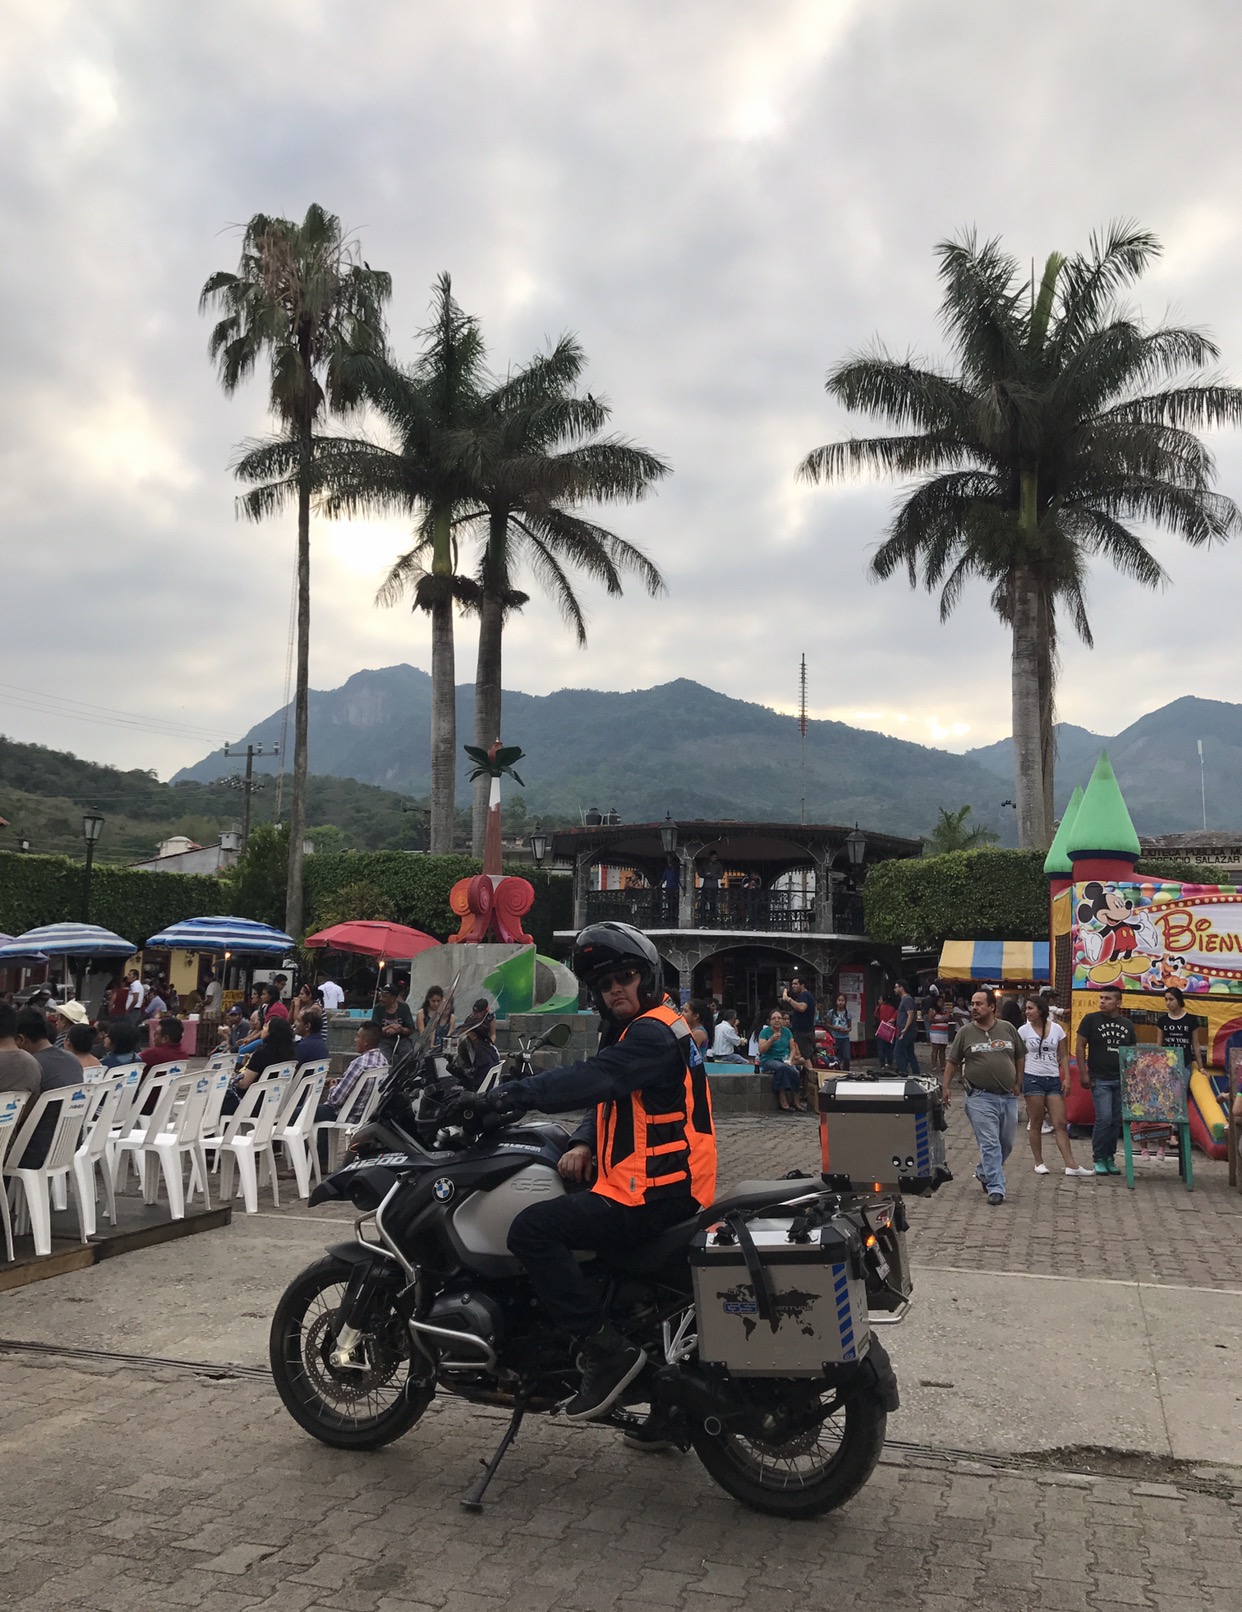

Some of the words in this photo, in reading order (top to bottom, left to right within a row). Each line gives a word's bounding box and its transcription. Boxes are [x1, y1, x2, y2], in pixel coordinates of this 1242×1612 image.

[1186, 848, 1226, 857] PUBLICA
[1195, 855, 1241, 864] SALAZAR
[1097, 1022, 1129, 1034] LEGENDS
[1163, 1024, 1189, 1032] LOVE
[1101, 1031, 1126, 1039] NEVER
[510, 1177, 553, 1193] GS
